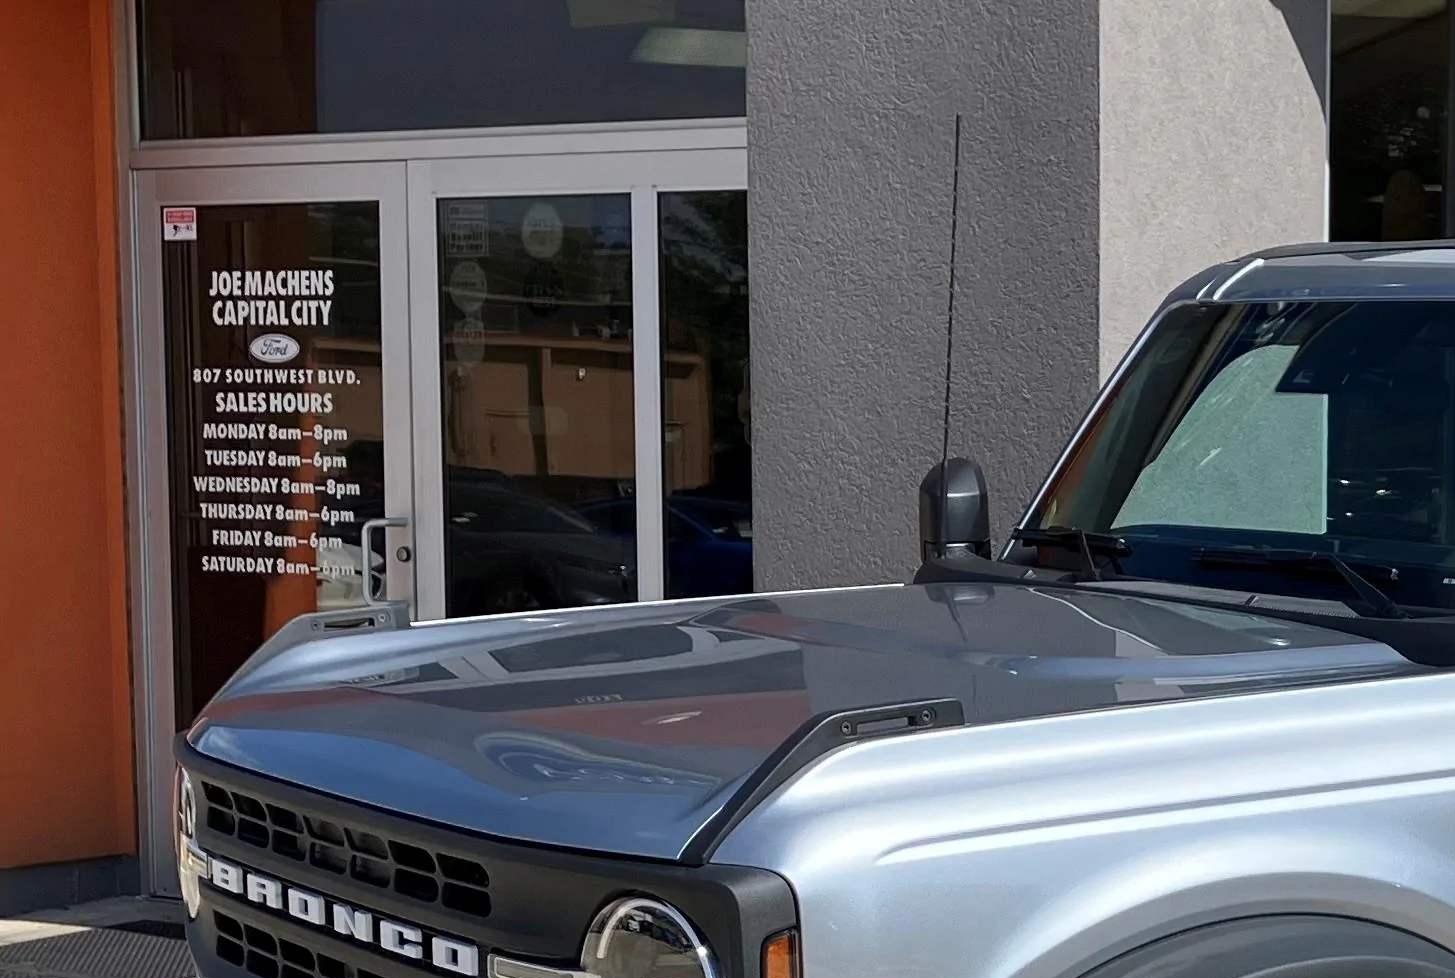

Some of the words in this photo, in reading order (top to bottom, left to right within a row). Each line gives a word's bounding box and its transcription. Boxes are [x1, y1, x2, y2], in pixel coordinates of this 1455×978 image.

[209, 270, 242, 297] JOE
[244, 269, 335, 297] MACHENS
[212, 300, 289, 326] CAPITAL
[290, 300, 332, 326] CITY
[260, 338, 289, 357] Ford
[193, 368, 222, 384] 807
[225, 368, 314, 384] SOUTHWEST
[317, 369, 361, 385] BLVD.
[215, 392, 267, 413] SALES
[269, 392, 333, 413] HOURS
[203, 423, 266, 440] MONDAY
[205, 450, 266, 467] TUESDAY
[193, 476, 279, 493] WEDNESDAY
[199, 503, 273, 520] THURSDAY
[212, 530, 262, 546] FRIDAY
[201, 556, 273, 573] SATURDAY
[208, 855, 480, 978] BRONCO
